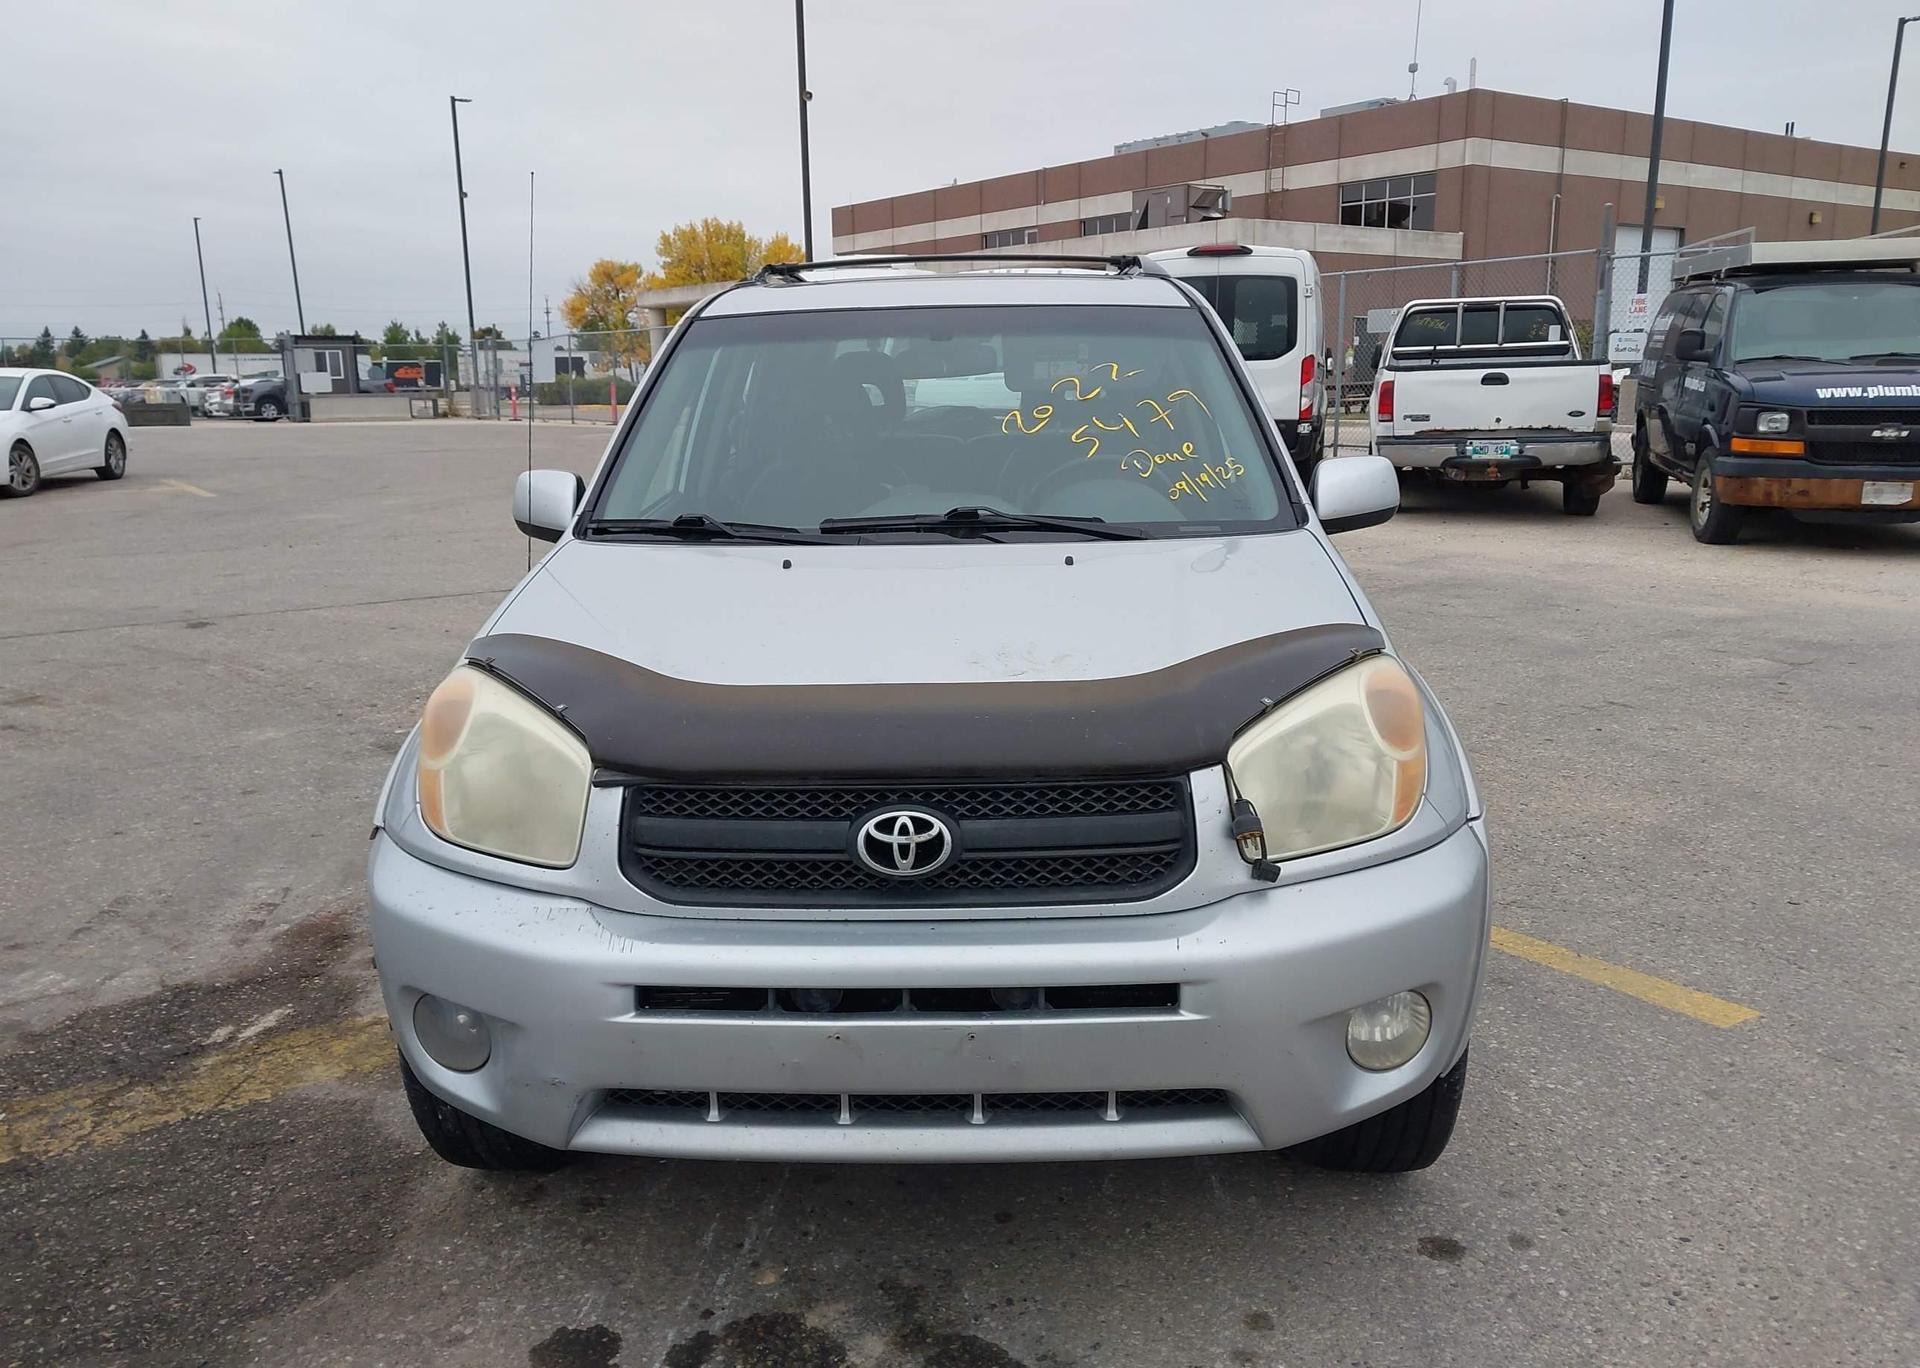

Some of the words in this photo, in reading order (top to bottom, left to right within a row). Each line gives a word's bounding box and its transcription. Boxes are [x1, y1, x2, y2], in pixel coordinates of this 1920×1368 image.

[1629, 306, 1648, 314] LANE
[1614, 345, 1627, 353] Staff
[1627, 344, 1641, 354] Only
[1070, 389, 1214, 458] 5479
[1121, 441, 1198, 478] Done
[1167, 457, 1245, 503] 09/19/25
